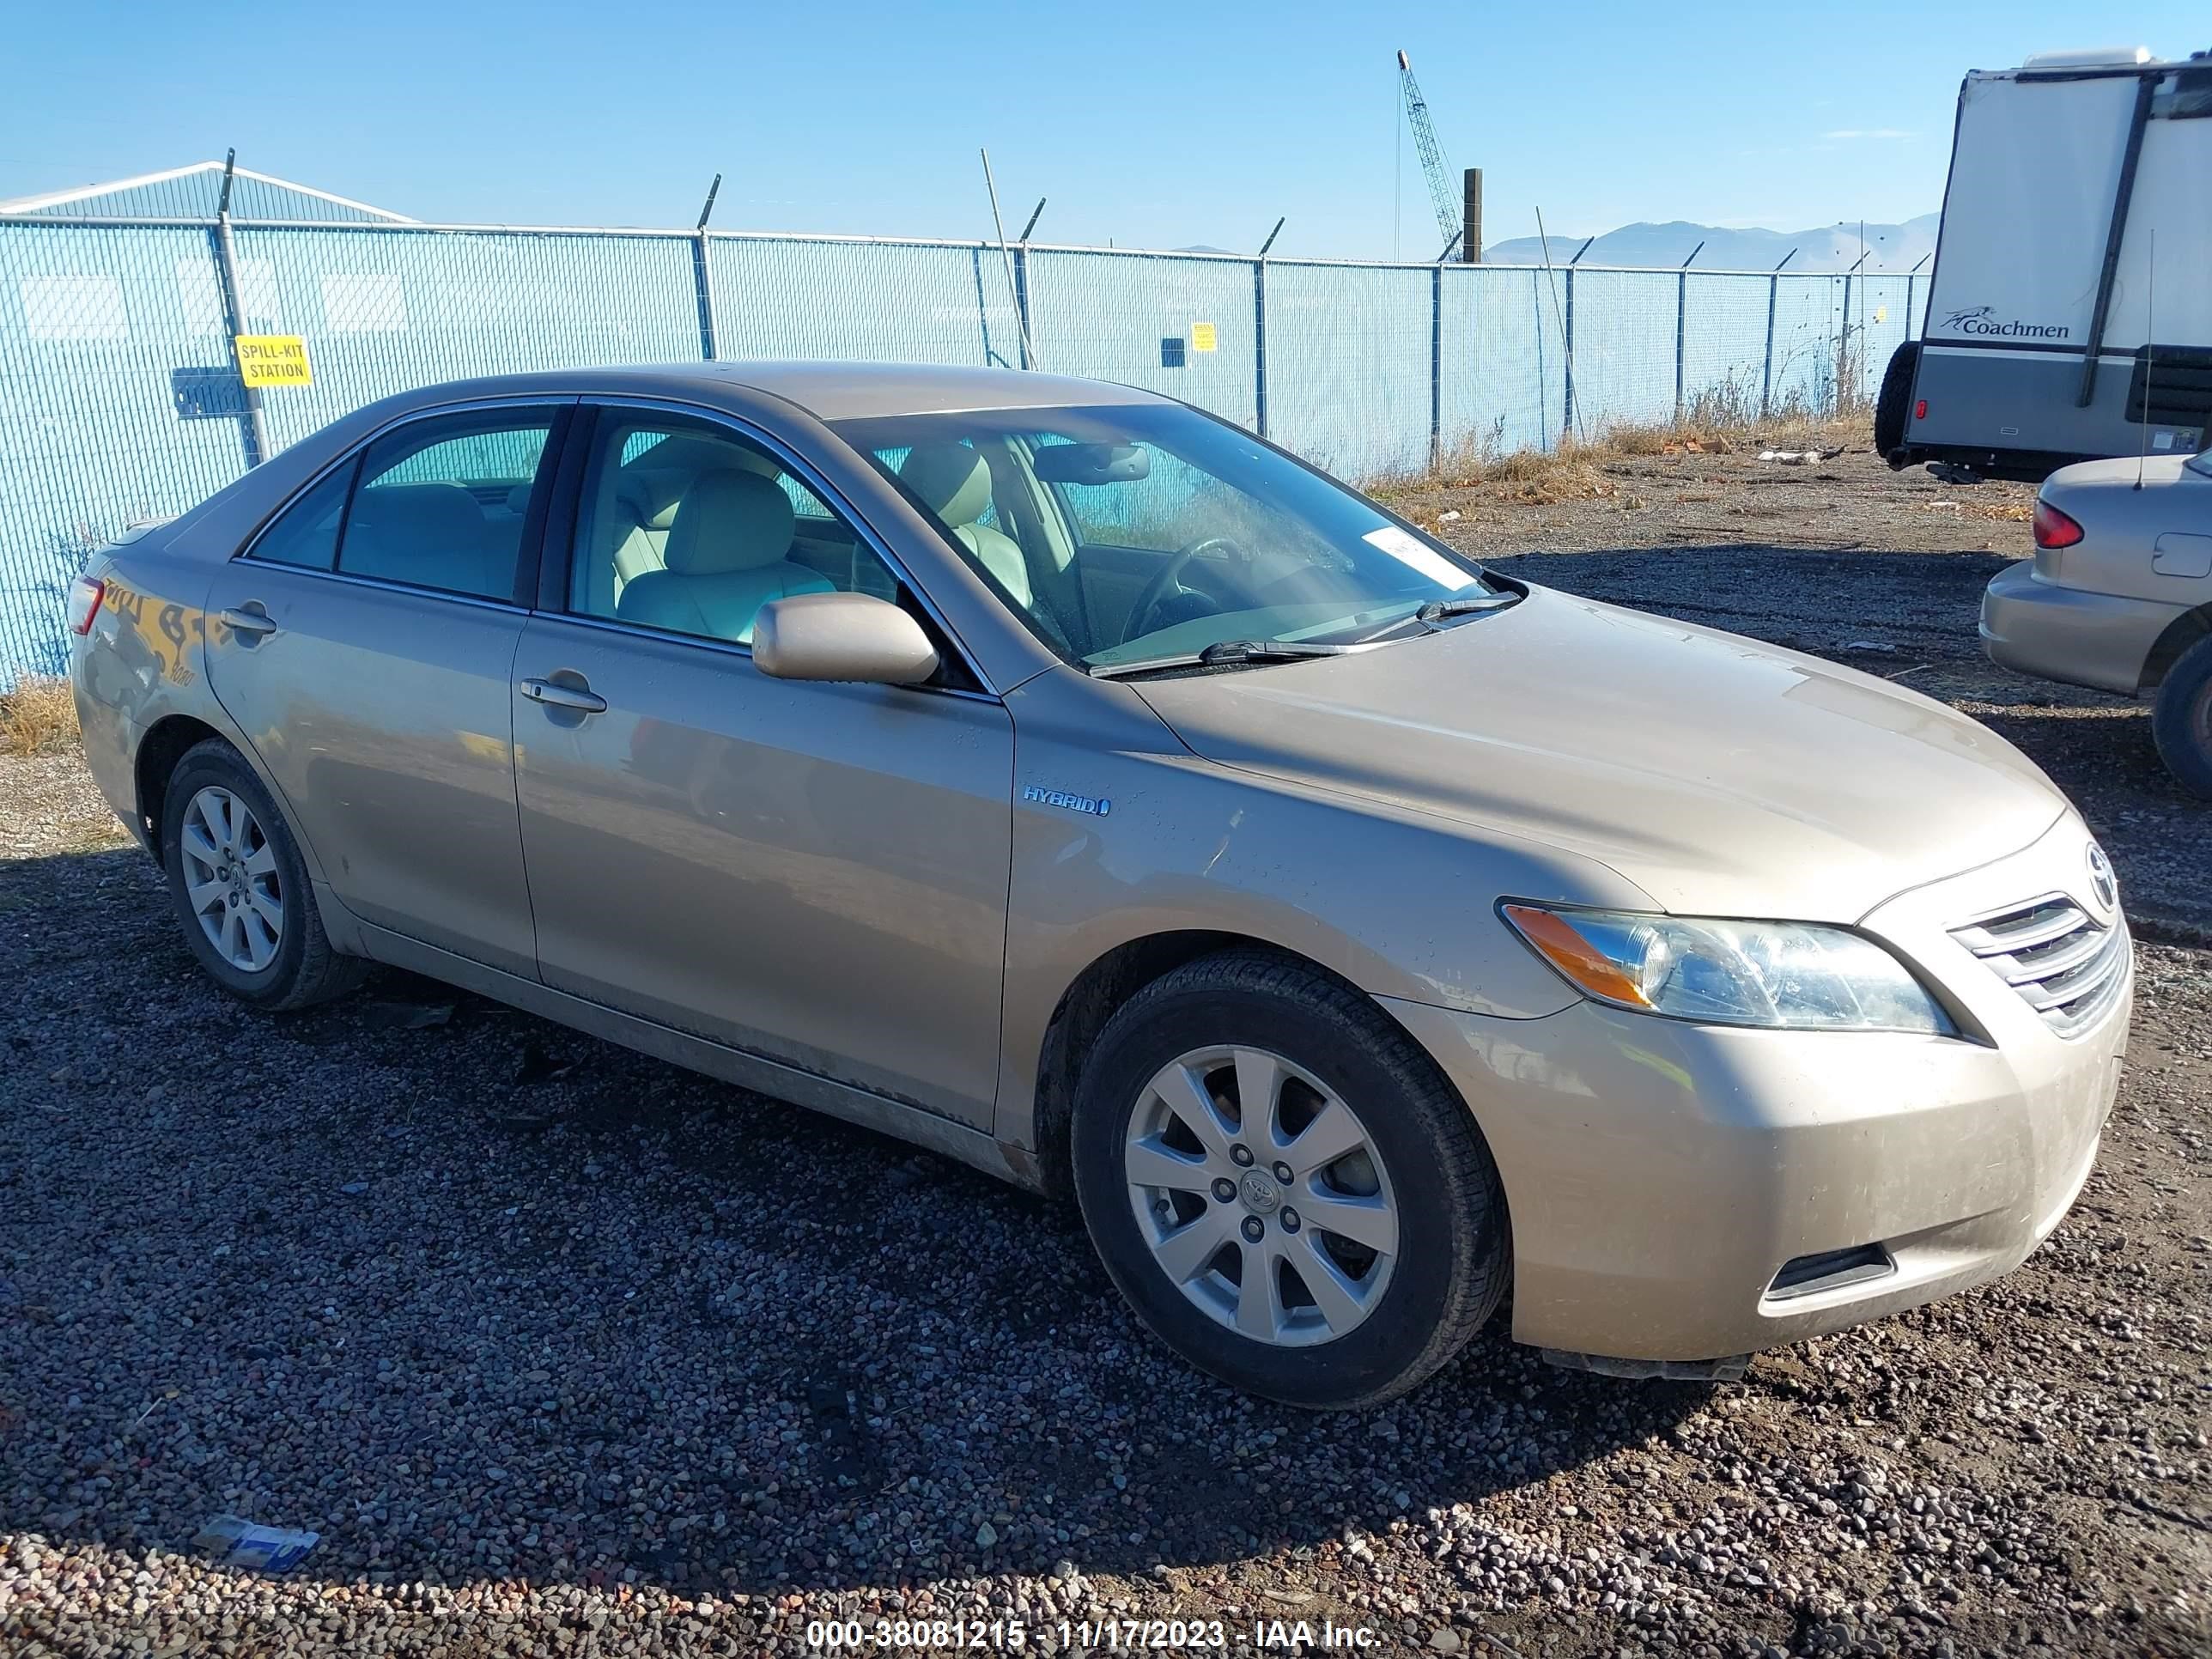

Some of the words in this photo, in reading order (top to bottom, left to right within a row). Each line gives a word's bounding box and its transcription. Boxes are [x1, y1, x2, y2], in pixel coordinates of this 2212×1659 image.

[1963, 319, 2069, 338] Coachmen
[241, 344, 303, 359] SPILL-KIT
[250, 363, 304, 378] STATION
[1024, 785, 1097, 815] HYBRID
